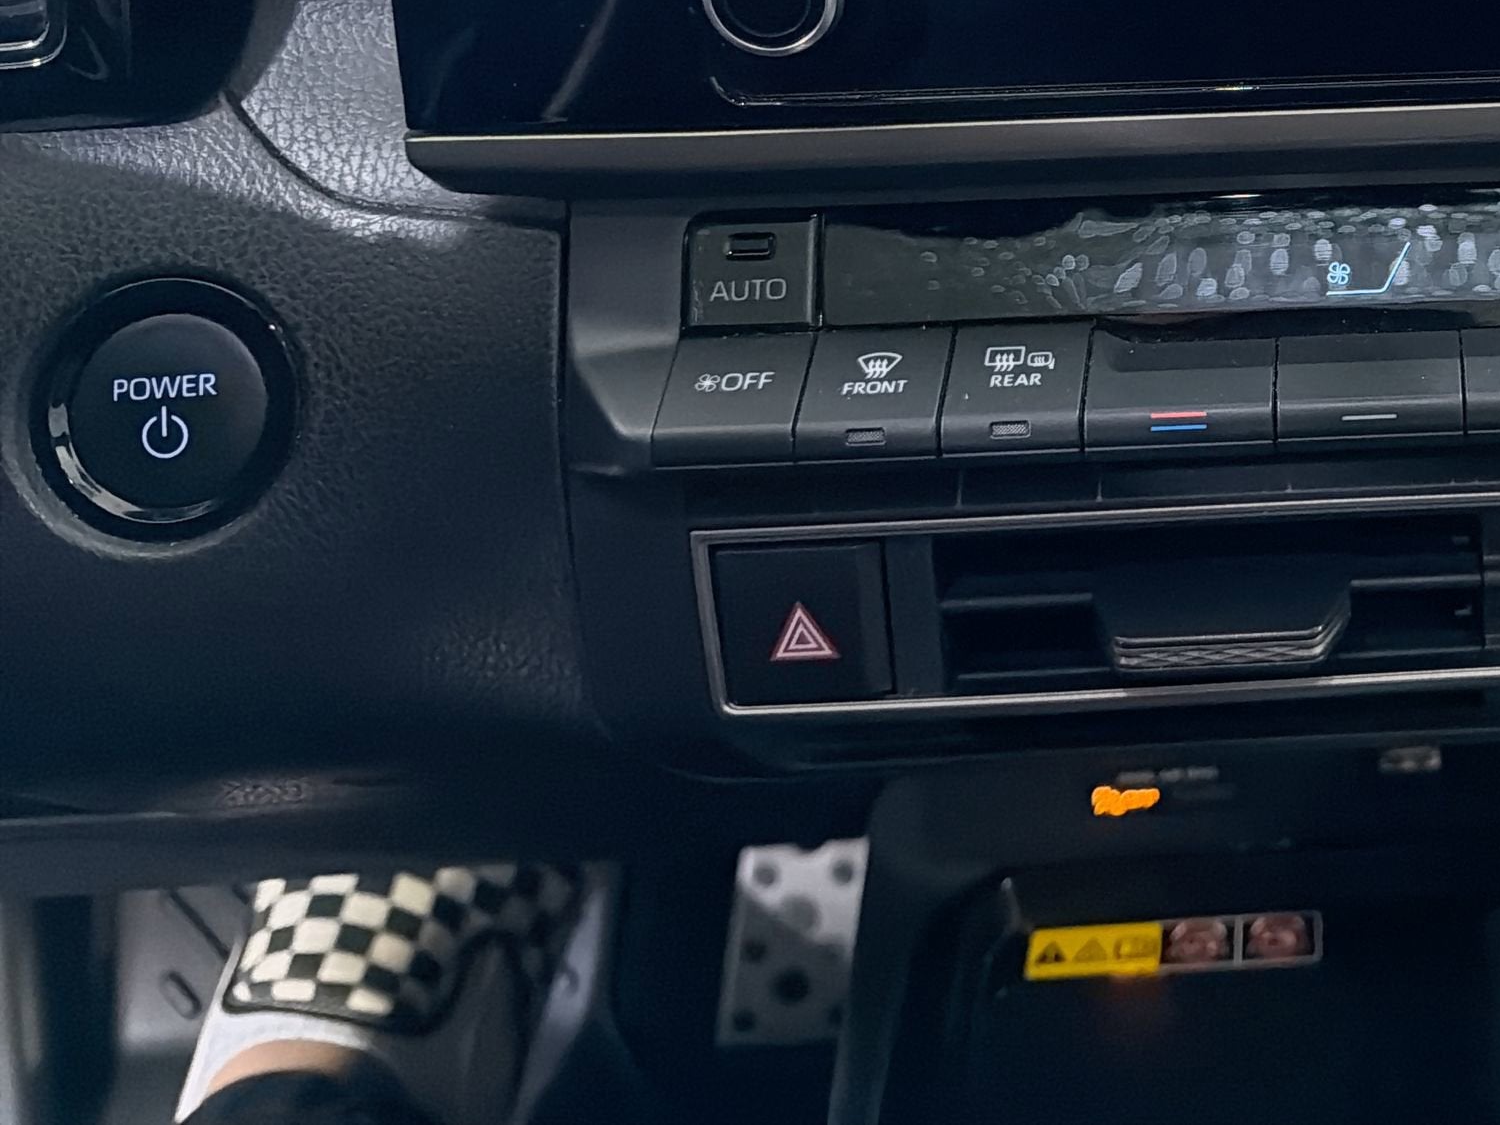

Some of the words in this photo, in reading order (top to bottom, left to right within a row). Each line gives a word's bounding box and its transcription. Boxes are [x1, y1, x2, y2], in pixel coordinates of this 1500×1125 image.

[709, 278, 787, 302] AUTO
[113, 373, 217, 402] POWER
[719, 371, 775, 392] OFF
[841, 379, 908, 396] FRONT
[989, 371, 1042, 388] REAR
